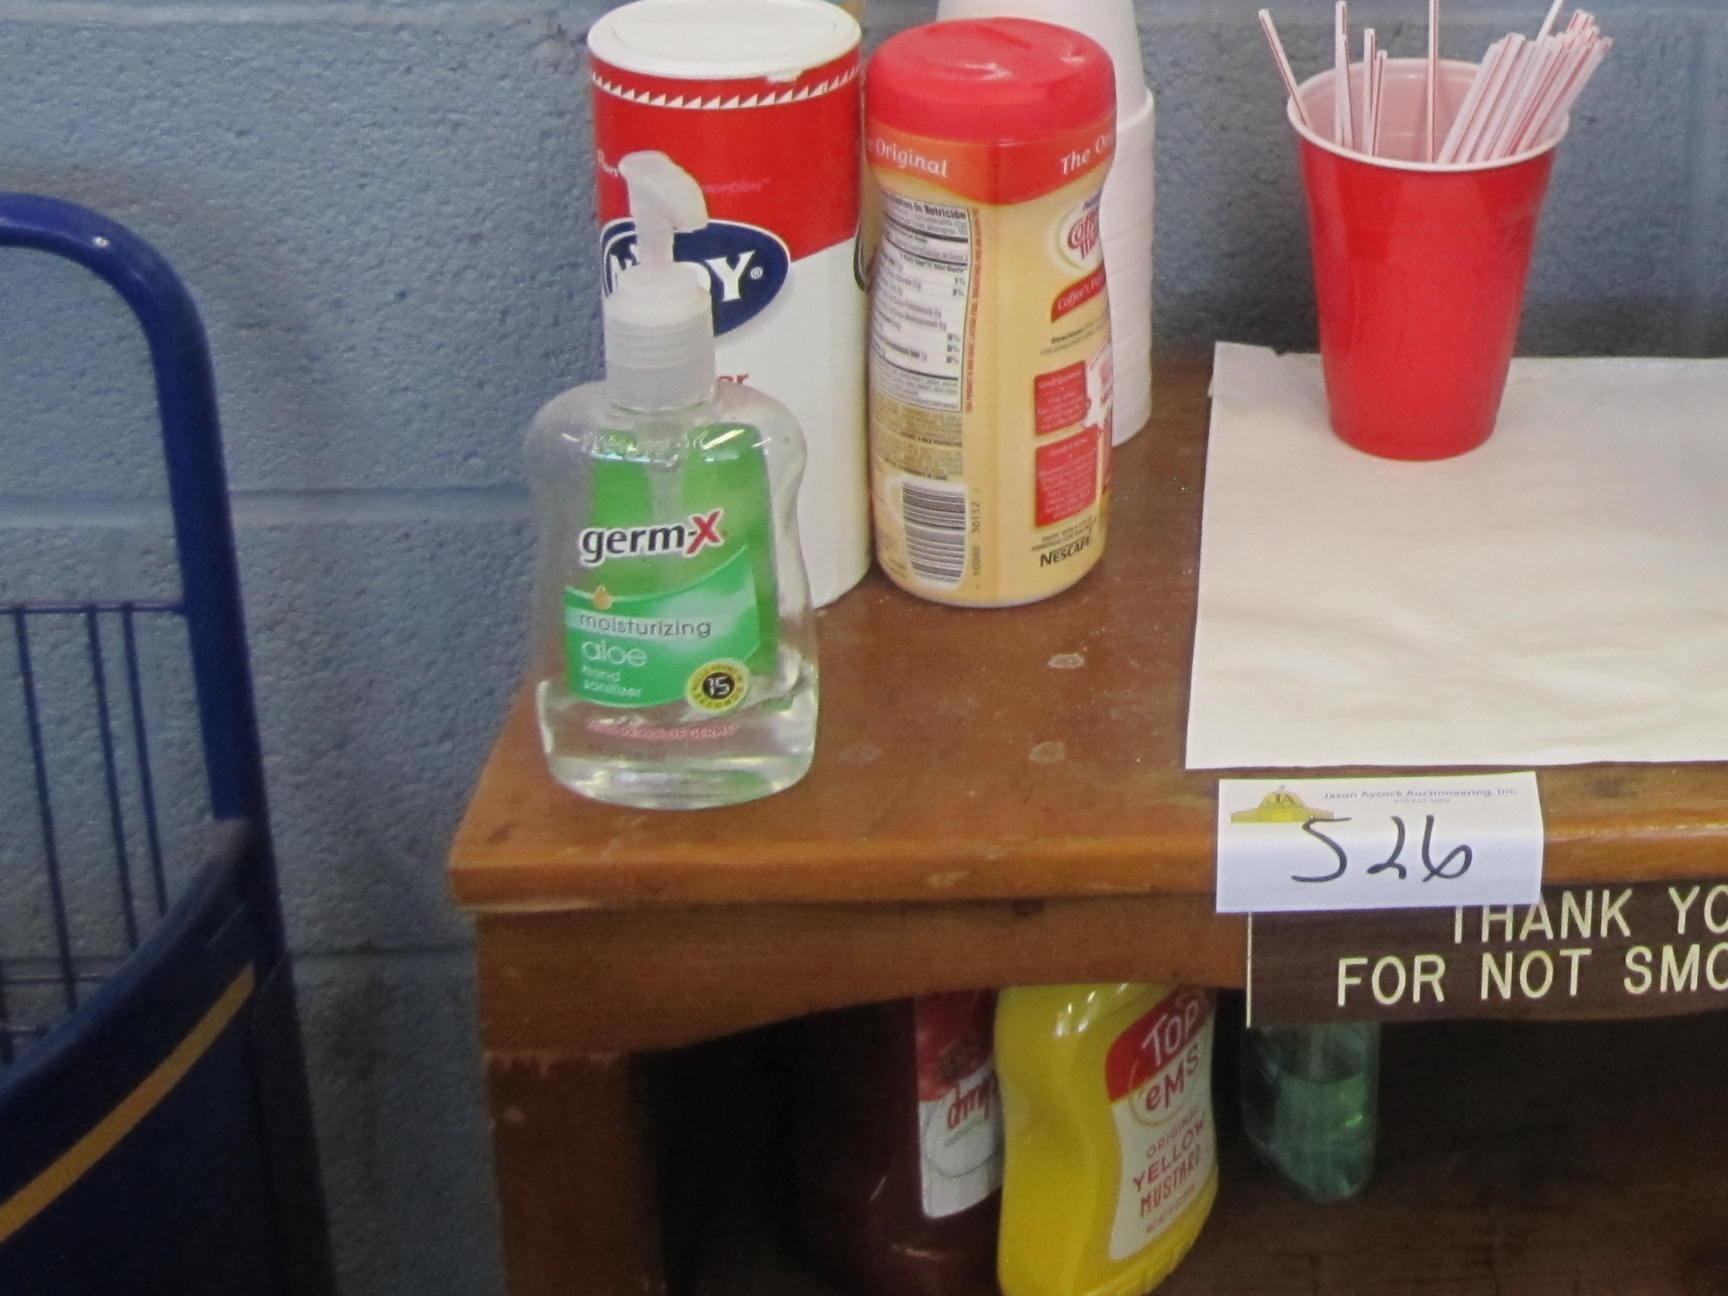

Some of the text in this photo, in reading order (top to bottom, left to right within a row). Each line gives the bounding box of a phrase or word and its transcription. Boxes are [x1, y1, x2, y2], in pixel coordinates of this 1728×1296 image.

[876, 137, 949, 179] Original
[1061, 149, 1091, 175] The
[579, 611, 712, 638] moisturizing
[581, 640, 647, 667] aloe
[582, 665, 621, 683] hand
[707, 675, 733, 698] 15
[583, 677, 644, 699] sanitizer
[1323, 791, 1357, 799] Jason
[1360, 790, 1403, 799] Aycock
[1497, 786, 1519, 796] Inc.
[1337, 953, 1446, 1007] FOR
[1480, 947, 1592, 1000] NOT
[1133, 1108, 1205, 1192] YELLOW
